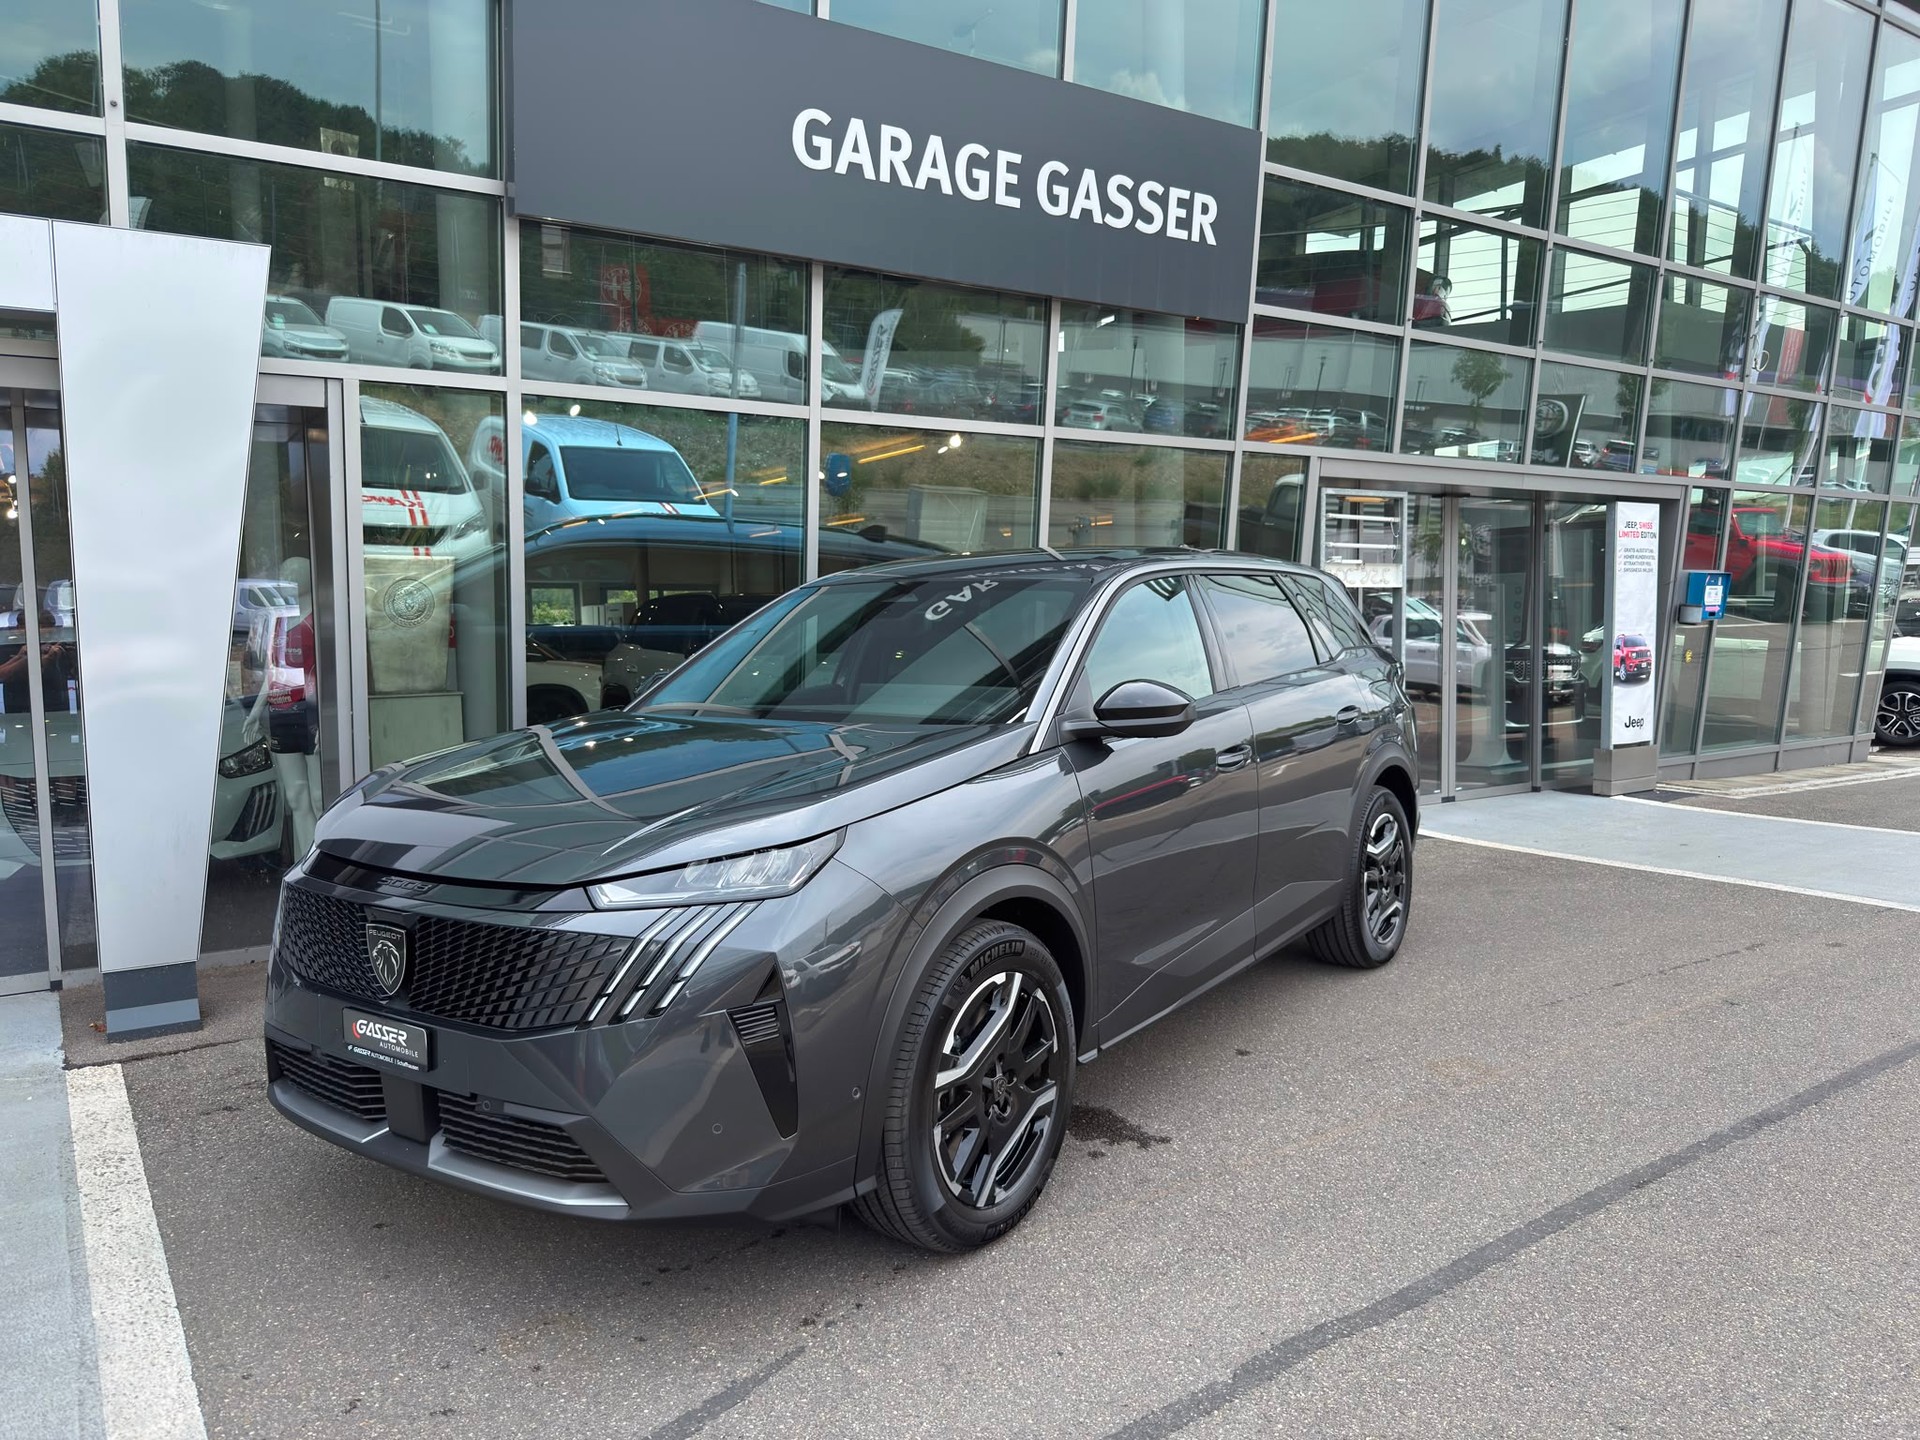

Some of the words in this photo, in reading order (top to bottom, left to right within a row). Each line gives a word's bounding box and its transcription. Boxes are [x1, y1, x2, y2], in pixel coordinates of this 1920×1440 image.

[791, 107, 1022, 210] GARAGE
[1036, 160, 1218, 246] GASSER
[1639, 521, 1653, 529] SWISS
[1624, 715, 1645, 730] Jeep
[377, 876, 432, 892] 5008
[368, 929, 402, 941] PEUGEOT
[969, 941, 1025, 978] MICHELIN
[355, 1019, 408, 1047] GASSER
[353, 1046, 371, 1057] GASSER
[371, 1052, 394, 1065] AUTOMOBILE
[379, 1041, 419, 1059] AUTOMOBILE
